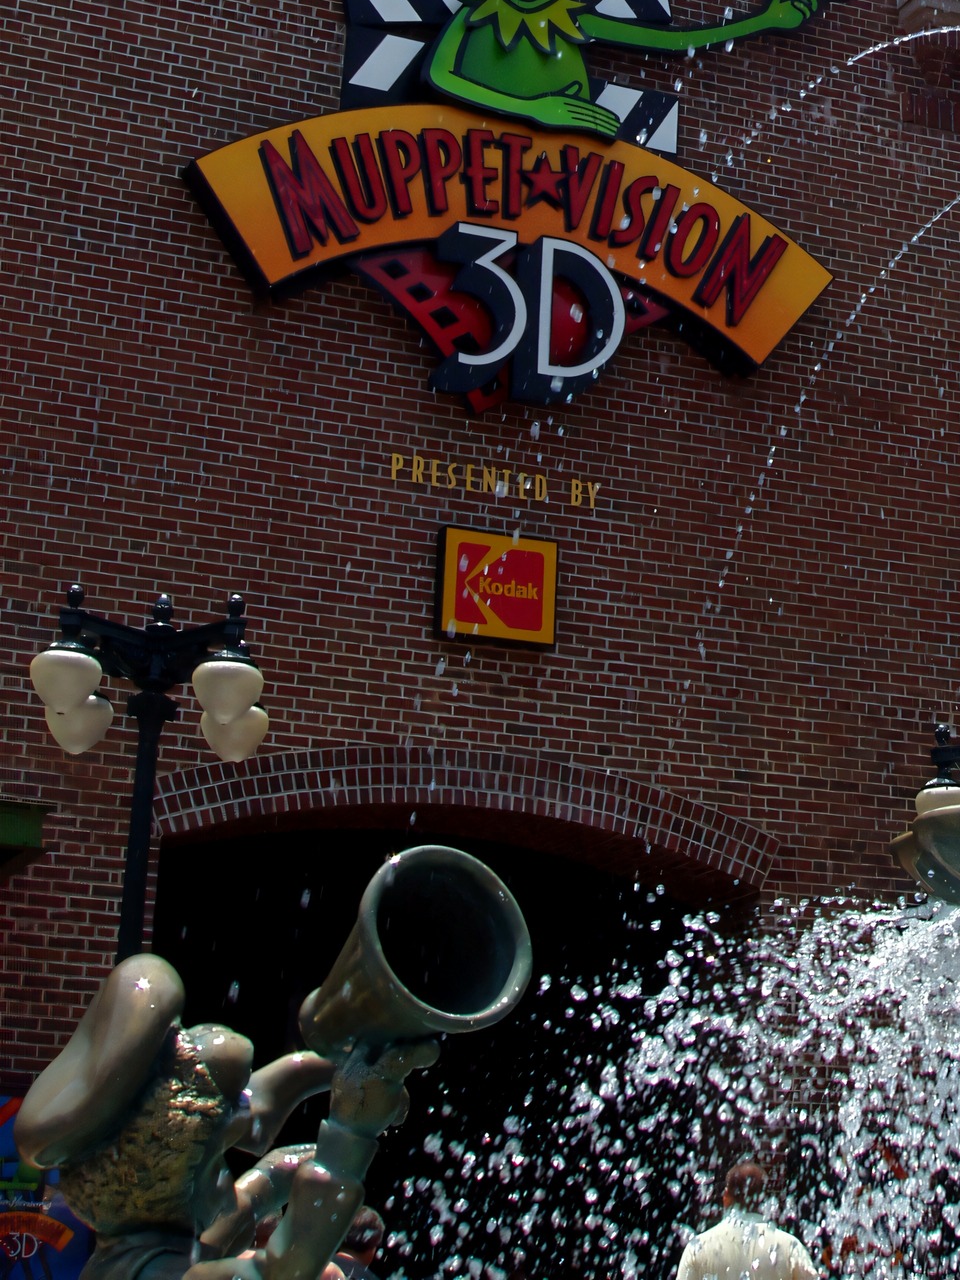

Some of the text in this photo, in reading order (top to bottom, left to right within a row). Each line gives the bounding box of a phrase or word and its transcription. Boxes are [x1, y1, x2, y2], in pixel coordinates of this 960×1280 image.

[455, 220, 628, 380] 3D
[391, 452, 602, 509] PRESENTED BY
[478, 576, 539, 601] Kodak
[8, 1232, 39, 1258] 3D
